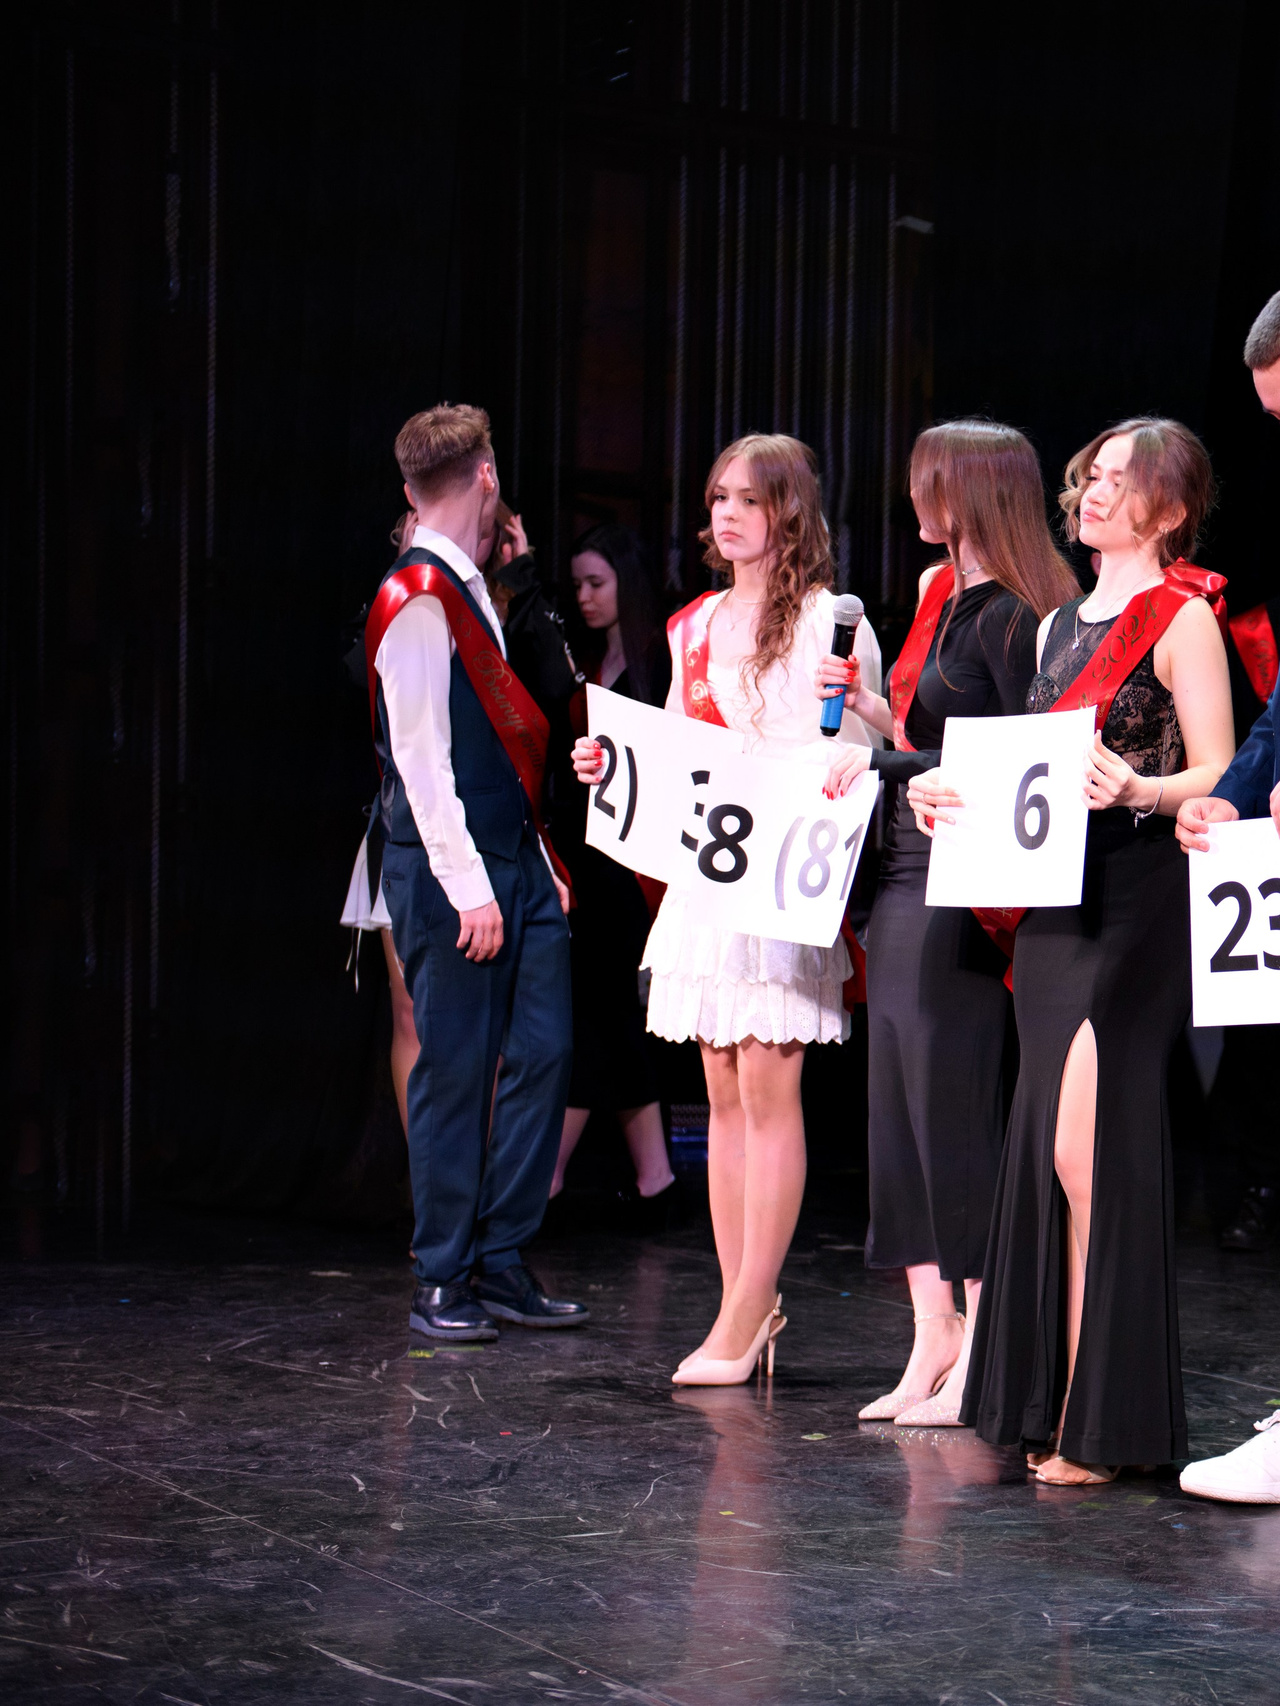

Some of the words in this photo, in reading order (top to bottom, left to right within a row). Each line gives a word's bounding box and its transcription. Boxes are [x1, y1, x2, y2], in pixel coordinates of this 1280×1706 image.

[1092, 589, 1160, 687] 2024
[1013, 762, 1050, 850] 6
[774, 816, 864, 911] (81
